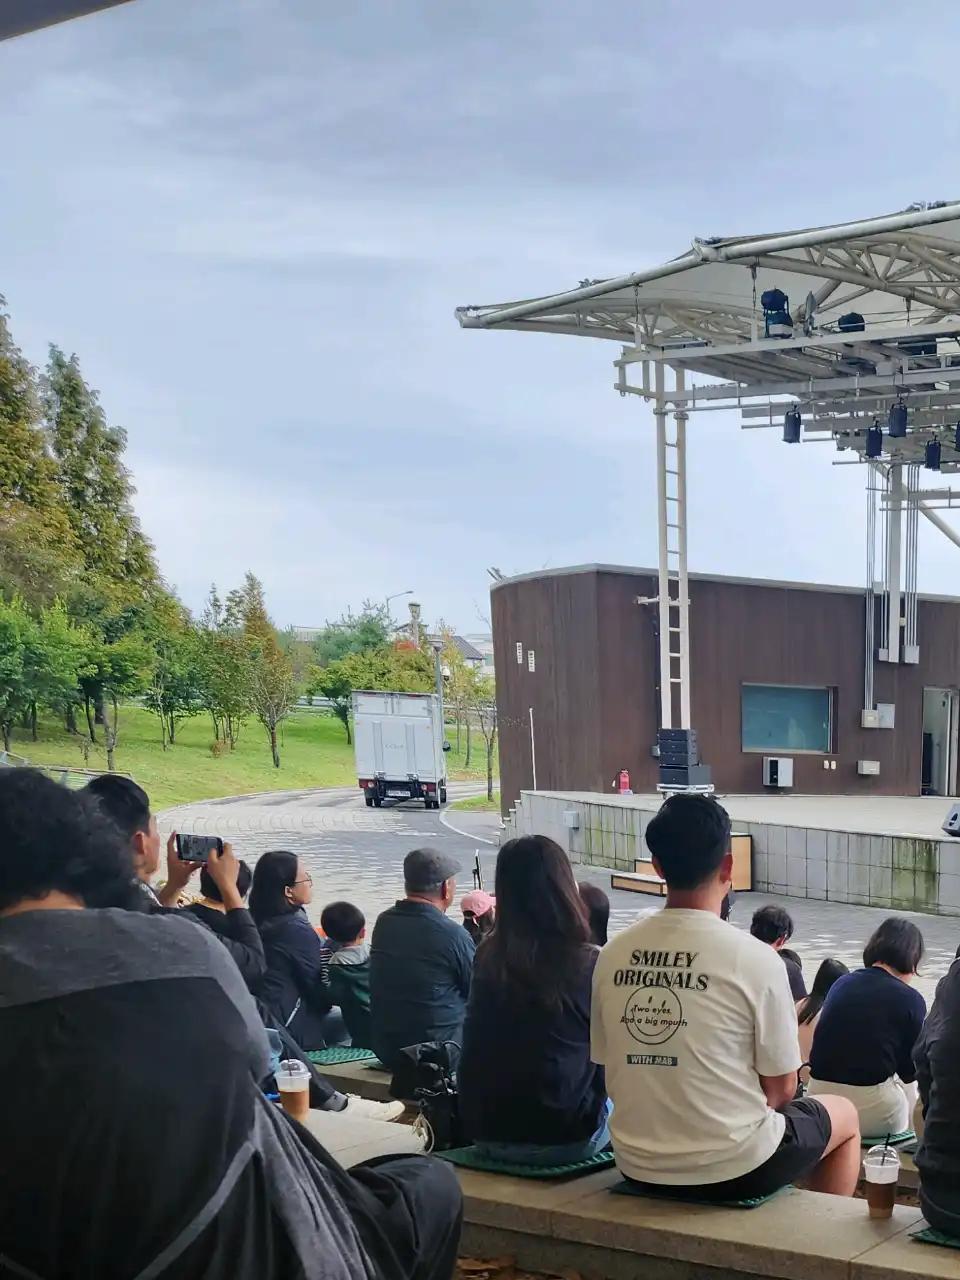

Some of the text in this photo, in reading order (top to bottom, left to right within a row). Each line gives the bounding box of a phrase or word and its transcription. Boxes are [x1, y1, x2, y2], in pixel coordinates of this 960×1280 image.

[630, 949, 698, 968] SMILEY
[614, 969, 709, 991] ORIGINALS
[633, 1004, 649, 1013] Two
[645, 1016, 658, 1026] big
[631, 1055, 653, 1064] WITH
